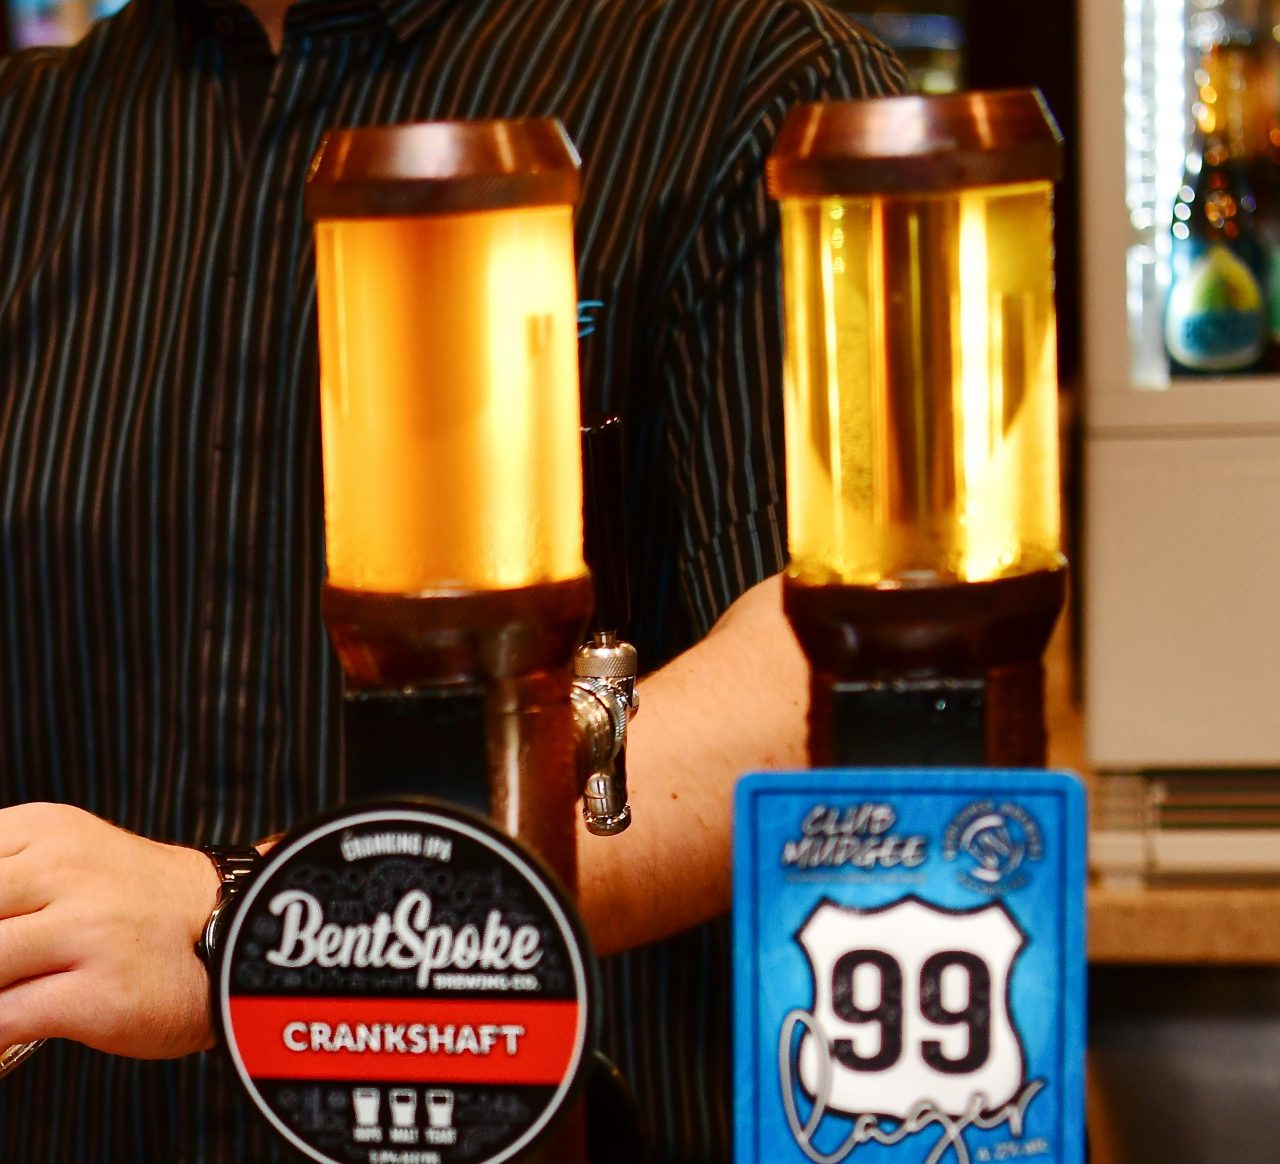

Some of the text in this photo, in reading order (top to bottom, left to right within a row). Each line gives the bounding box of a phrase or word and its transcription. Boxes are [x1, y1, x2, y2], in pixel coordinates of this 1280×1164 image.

[781, 835, 928, 869] MUDGEE
[266, 888, 545, 990] BentSpoke
[282, 1020, 526, 1056] CRANKSHAFT
[831, 949, 992, 1075] 99
